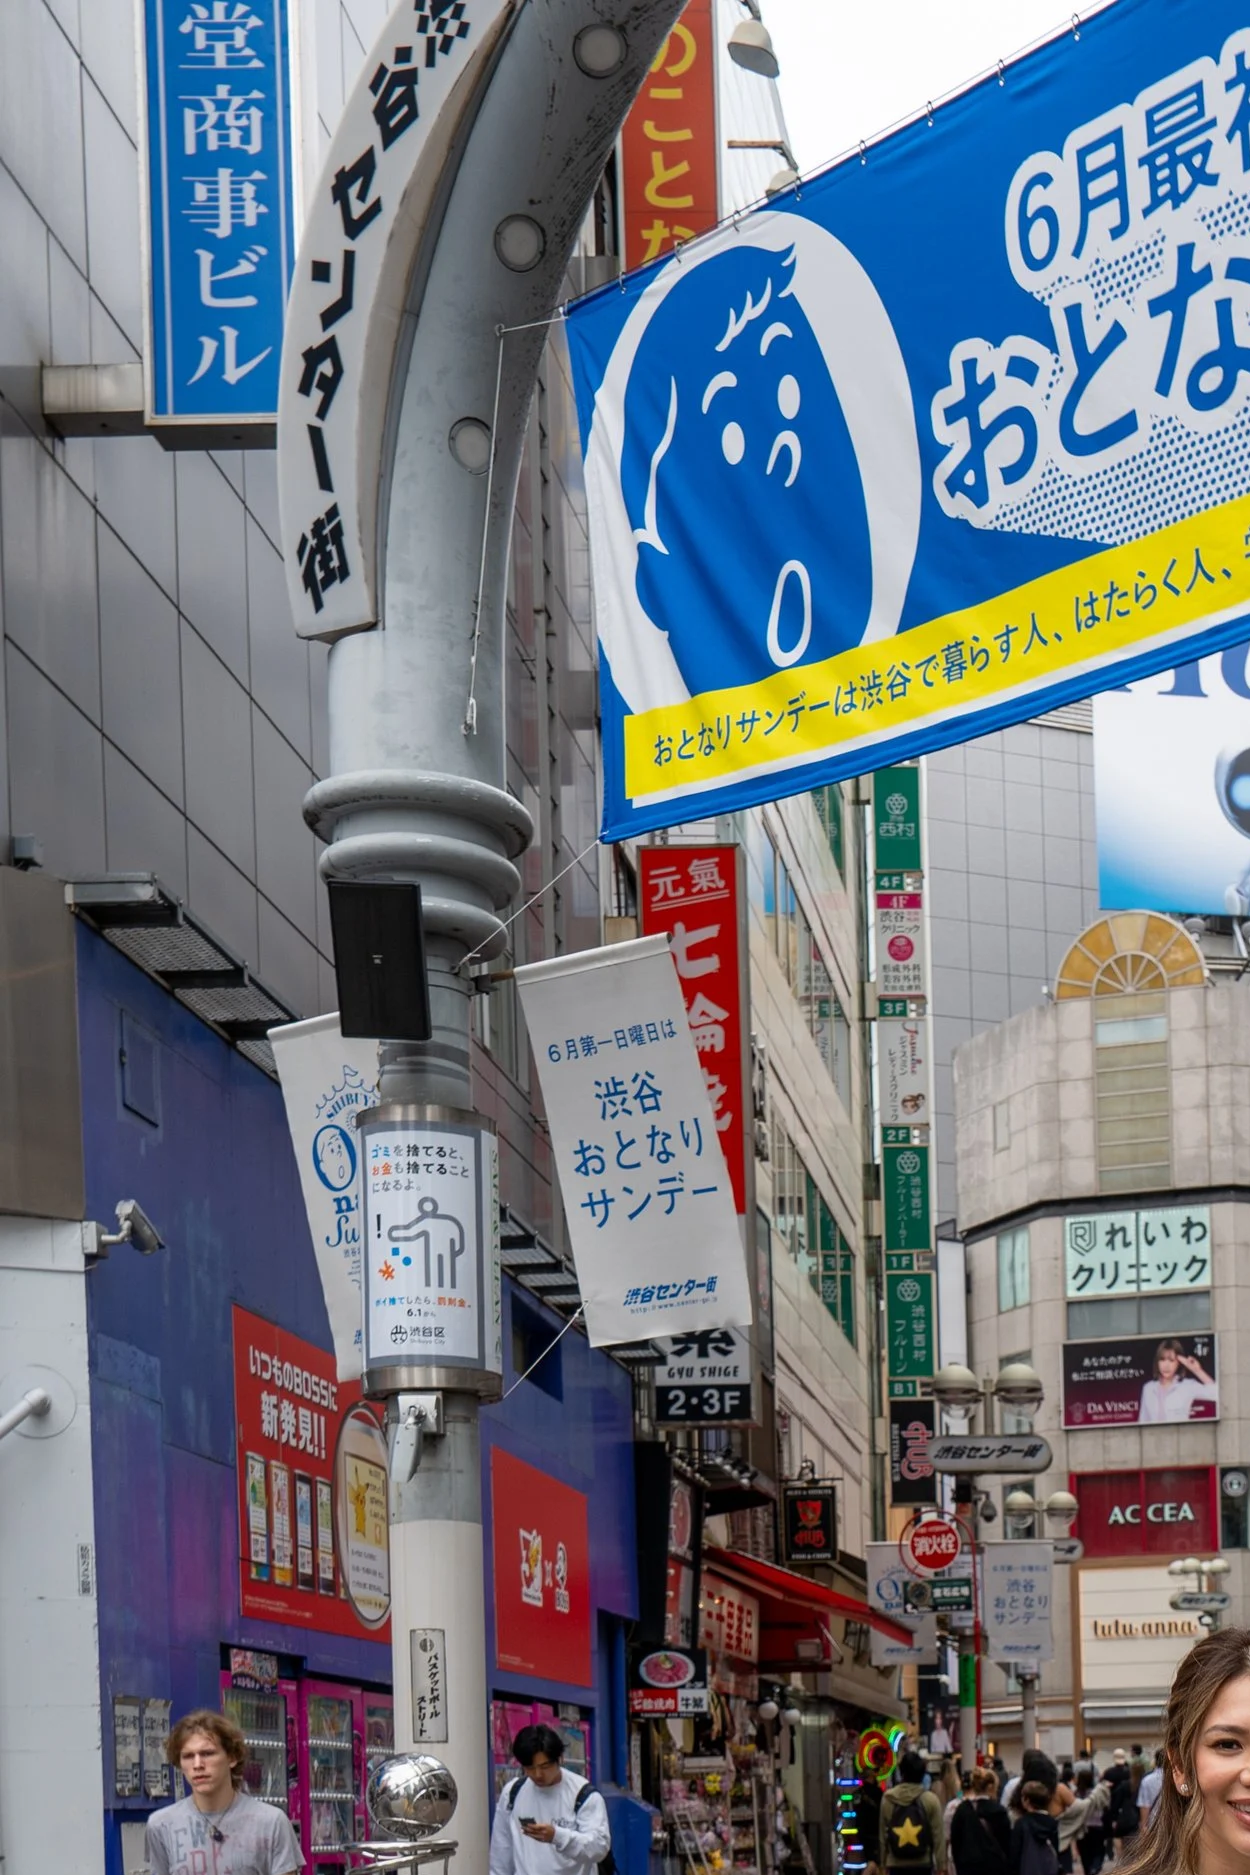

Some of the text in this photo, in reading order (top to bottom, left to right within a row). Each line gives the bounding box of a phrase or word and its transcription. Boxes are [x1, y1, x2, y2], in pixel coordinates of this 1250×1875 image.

[178, 0, 272, 386] 堂商事ビル
[297, 0, 470, 614] 渋谷センター街
[879, 822, 915, 837] 西村
[880, 876, 901, 888] 4F
[880, 925, 921, 934] クリニック
[884, 1002, 905, 1014] 3F
[547, 1018, 678, 1063] 6月第一日曜日は
[593, 1070, 663, 1121] 渋谷
[887, 1129, 907, 1142] 2F
[573, 1117, 703, 1177] おとなり
[371, 1161, 471, 1178] お金も捨てること
[580, 1171, 718, 1228] サンデー
[1104, 1215, 1208, 1251] れいわ
[890, 1255, 910, 1268] 1F
[1071, 1255, 1208, 1292] クリニック
[623, 1276, 718, 1306] 渋谷センター街
[410, 1325, 446, 1338] 渋谷区
[911, 1303, 926, 1363] 渋谷西村
[249, 1344, 338, 1412] いつものBOSSに
[668, 1365, 740, 1380] GYU SHIGE
[893, 1382, 914, 1395] B1
[1105, 1401, 1139, 1412] VINCI
[934, 1443, 1044, 1460] 渋谷センター街
[913, 1533, 956, 1557] 消火栓
[1006, 1578, 1036, 1593] 渋谷
[993, 1595, 1048, 1610] おとなり
[994, 1611, 1049, 1625] サンデー
[428, 1652, 441, 1720] バスケットボール
[417, 1695, 427, 1737] ストリート
